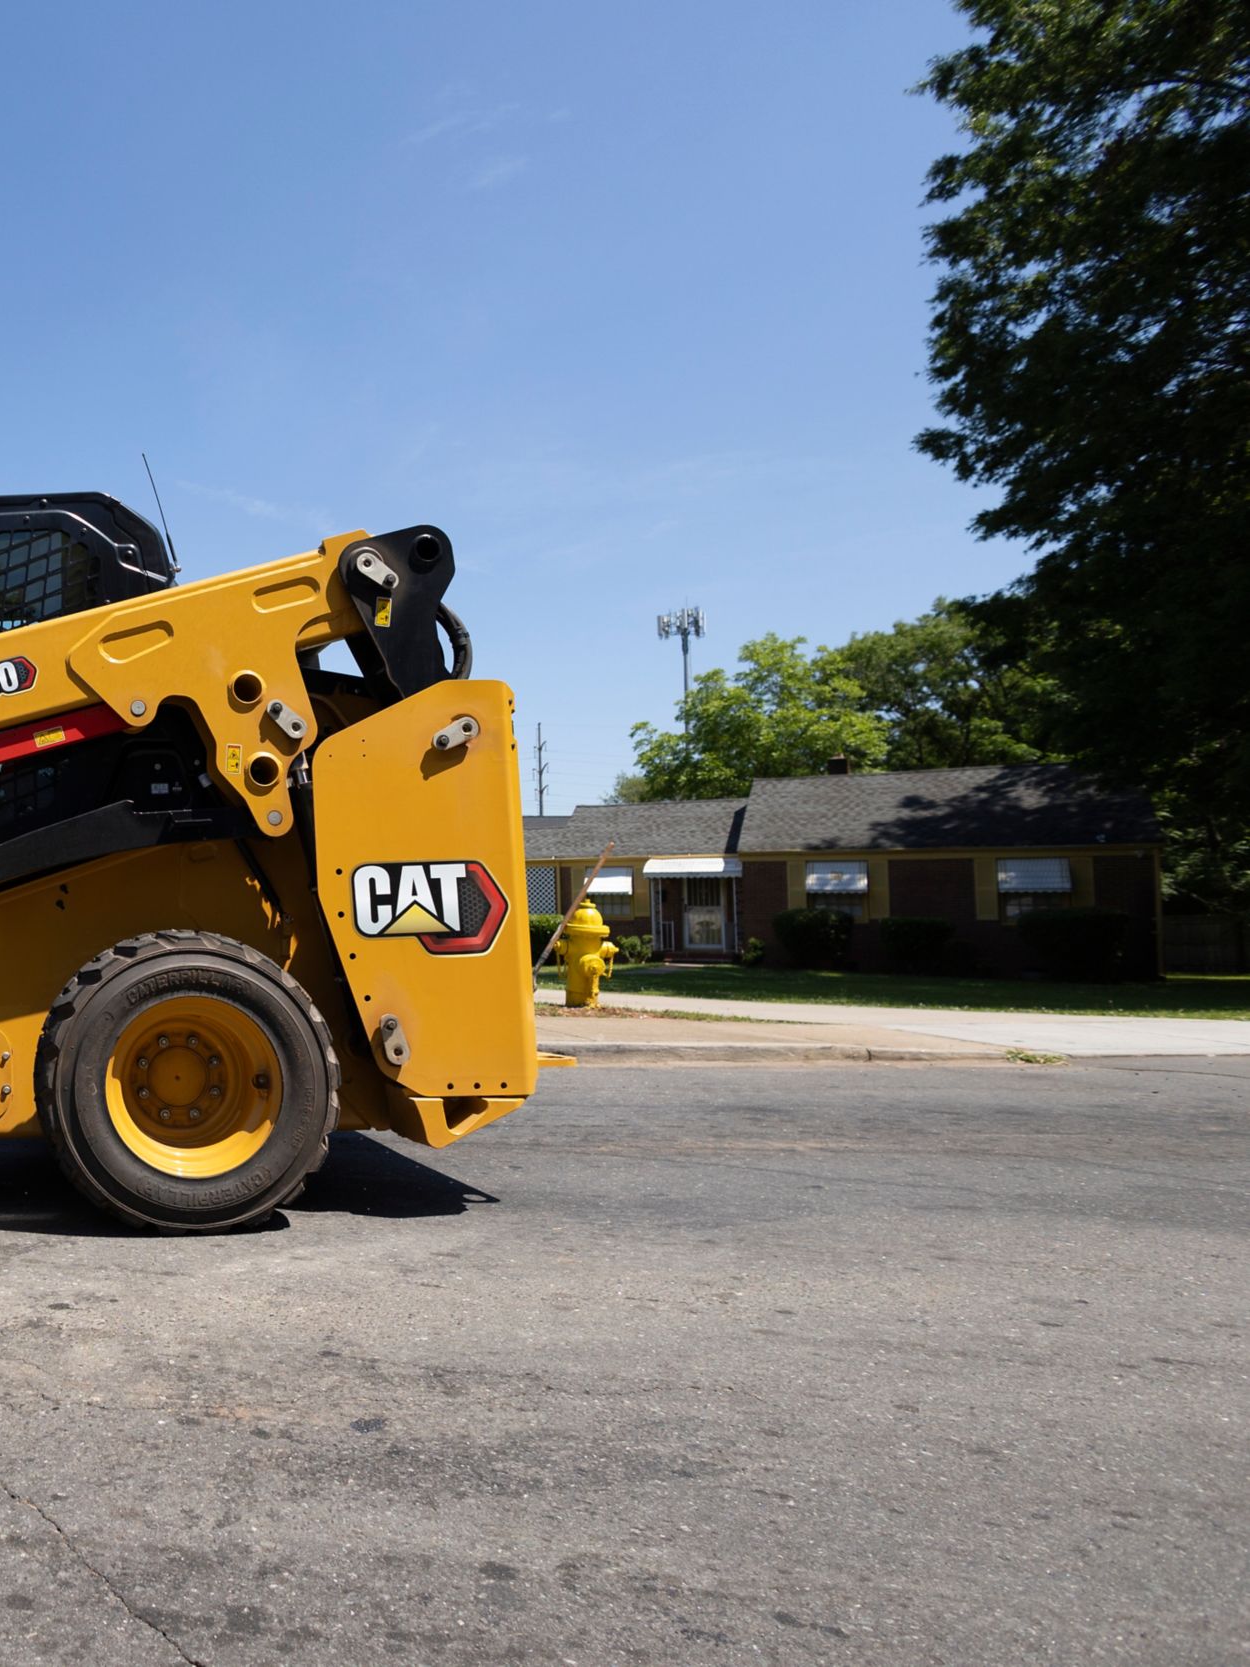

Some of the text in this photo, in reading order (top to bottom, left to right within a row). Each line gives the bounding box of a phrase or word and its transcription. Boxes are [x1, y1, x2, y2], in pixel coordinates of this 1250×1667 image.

[353, 863, 467, 935] CAT
[127, 969, 246, 1005] CATERPILLAR
[140, 1172, 265, 1207] CATERPILLAR
